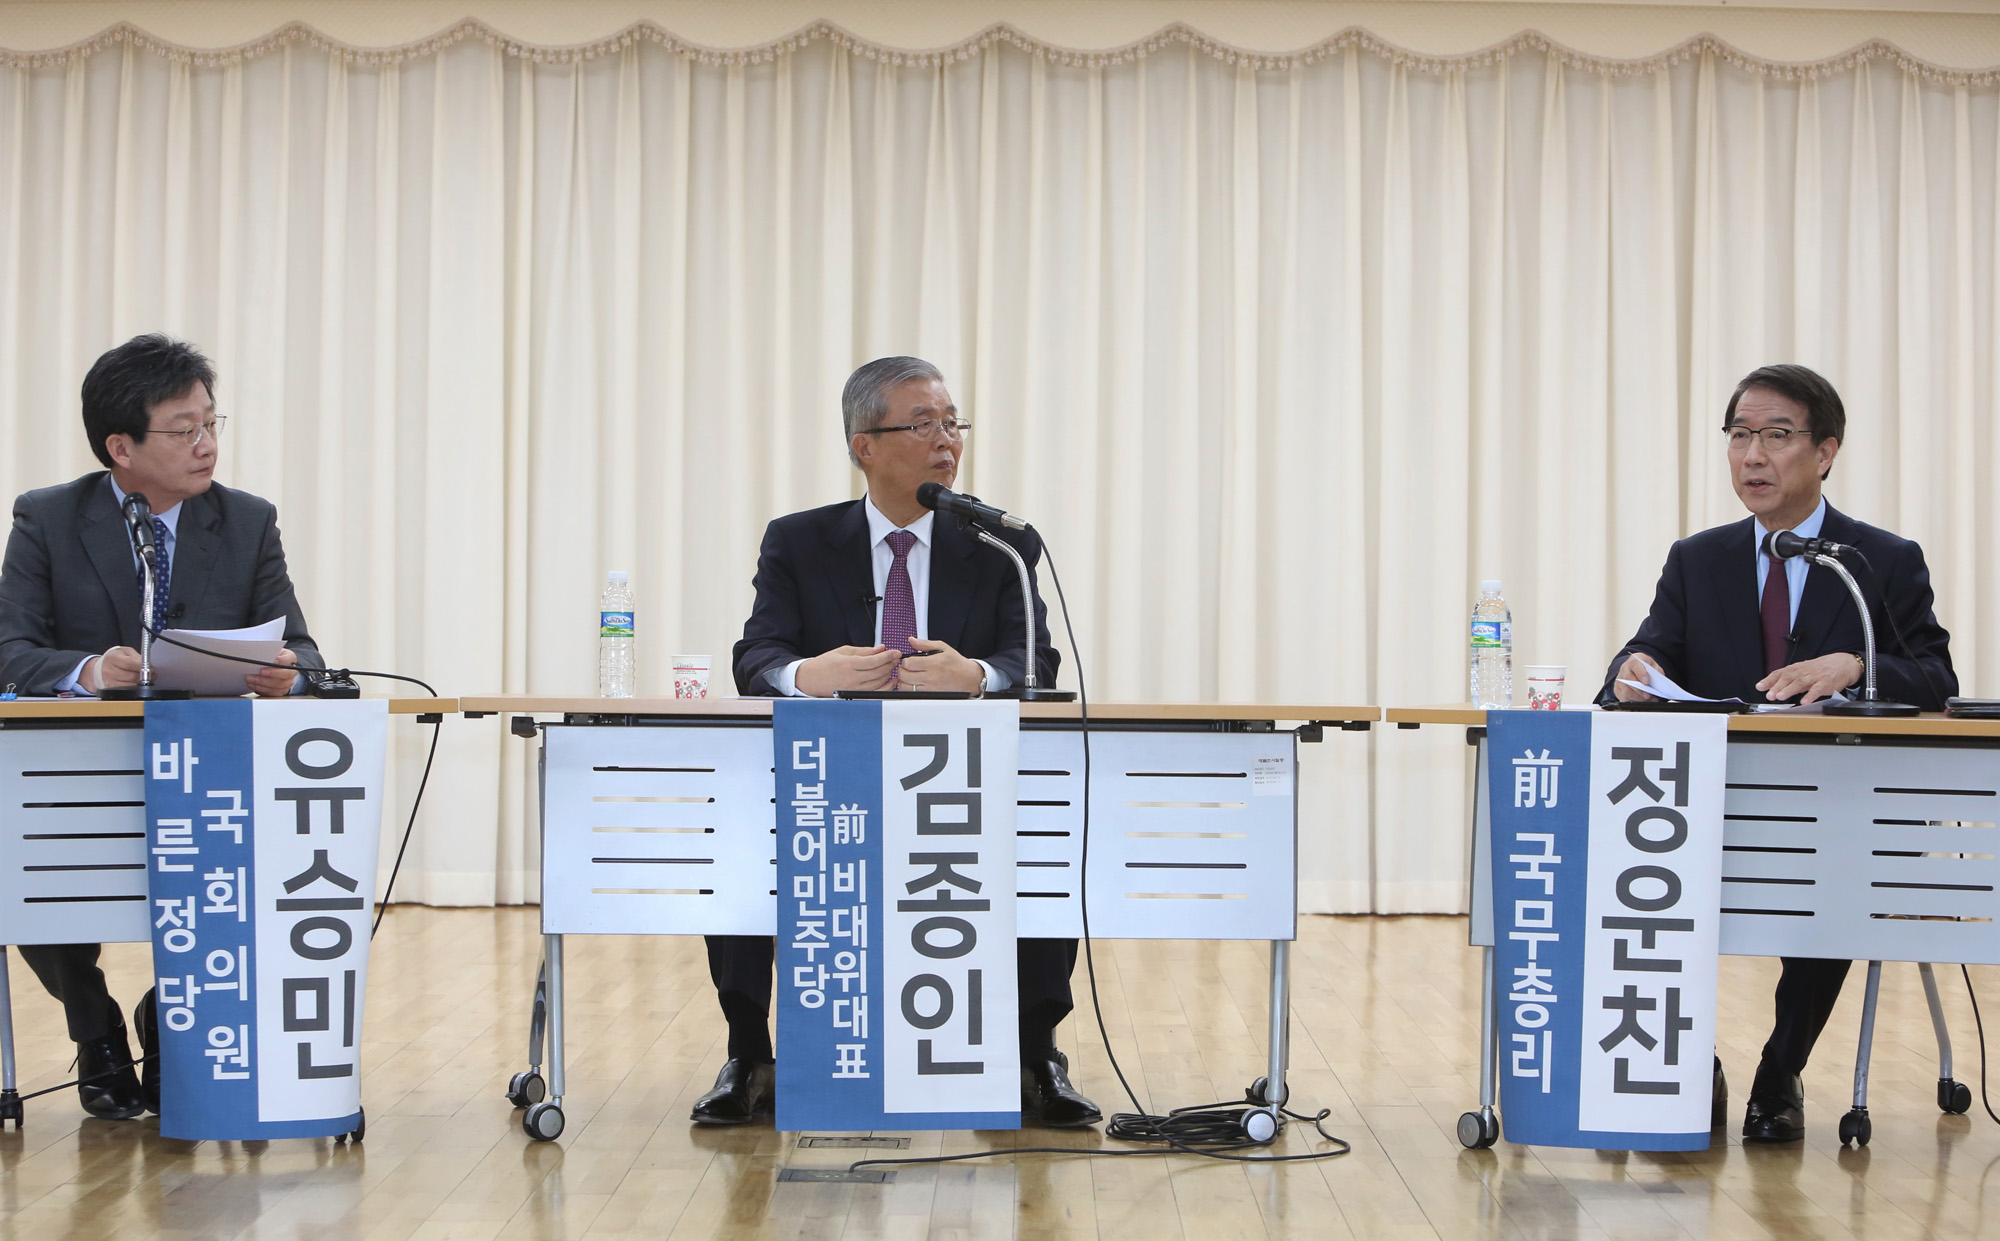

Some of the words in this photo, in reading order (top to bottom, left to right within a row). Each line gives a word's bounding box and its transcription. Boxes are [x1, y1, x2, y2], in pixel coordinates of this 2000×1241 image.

[152, 738, 201, 1032] 바른정당
[274, 727, 365, 1079] 유승민
[791, 737, 830, 1009] 더불어민주당
[831, 803, 868, 845] 前
[897, 727, 990, 1075] 김종인
[1512, 748, 1563, 809] 前
[1598, 741, 1694, 1096] 정운찬
[201, 790, 250, 1079] 국회의원
[832, 859, 870, 1079] 비대위대표
[1509, 832, 1562, 1094] 국무총리
